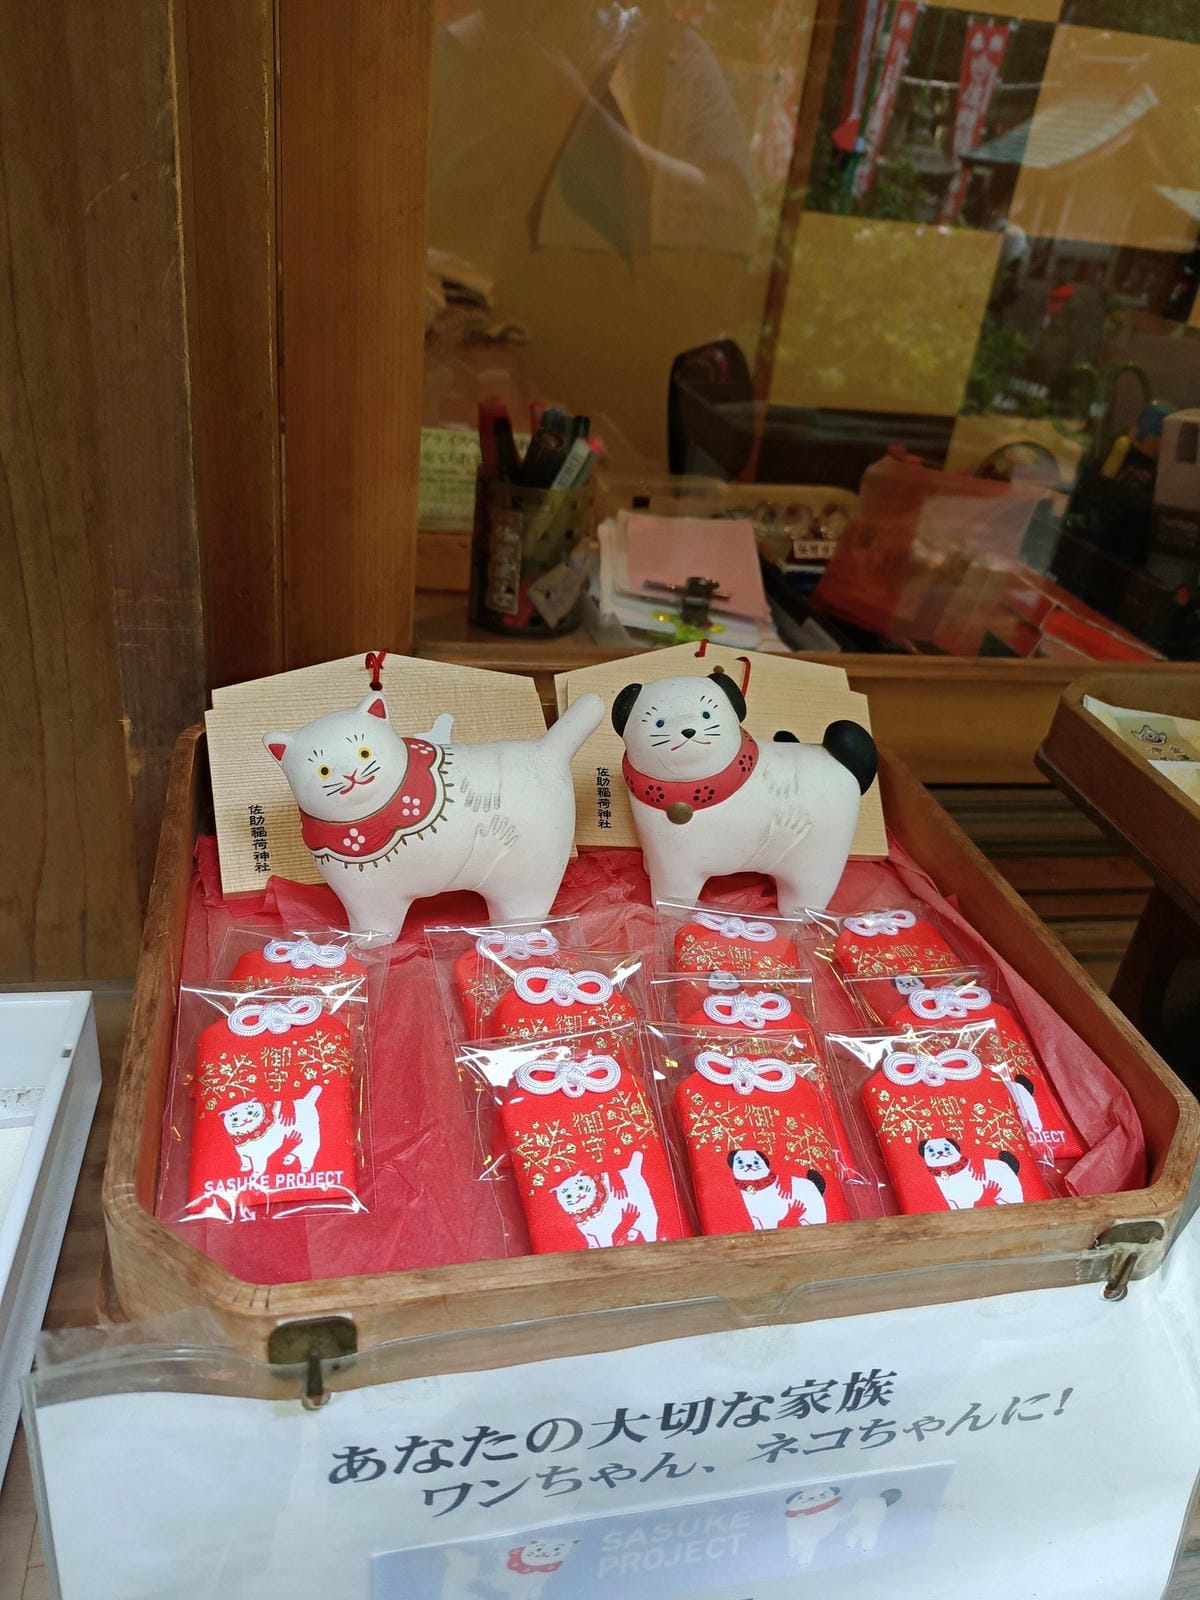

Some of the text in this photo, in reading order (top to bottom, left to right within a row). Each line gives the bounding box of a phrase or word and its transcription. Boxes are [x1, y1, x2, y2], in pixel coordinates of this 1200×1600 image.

[595, 766, 612, 829] 佐助稲荷神社
[248, 804, 271, 873] 佐助稲荷神社
[260, 1046, 292, 1093] 御守
[571, 1110, 606, 1163] 御守
[744, 1103, 776, 1155] 御守
[929, 1096, 965, 1141] 御守
[204, 1170, 344, 1194] SASUKE PROJECT
[328, 1368, 898, 1484] あなたの大切な家族
[601, 1509, 754, 1552] SASUKE
[598, 1532, 748, 1579] PROJECT
